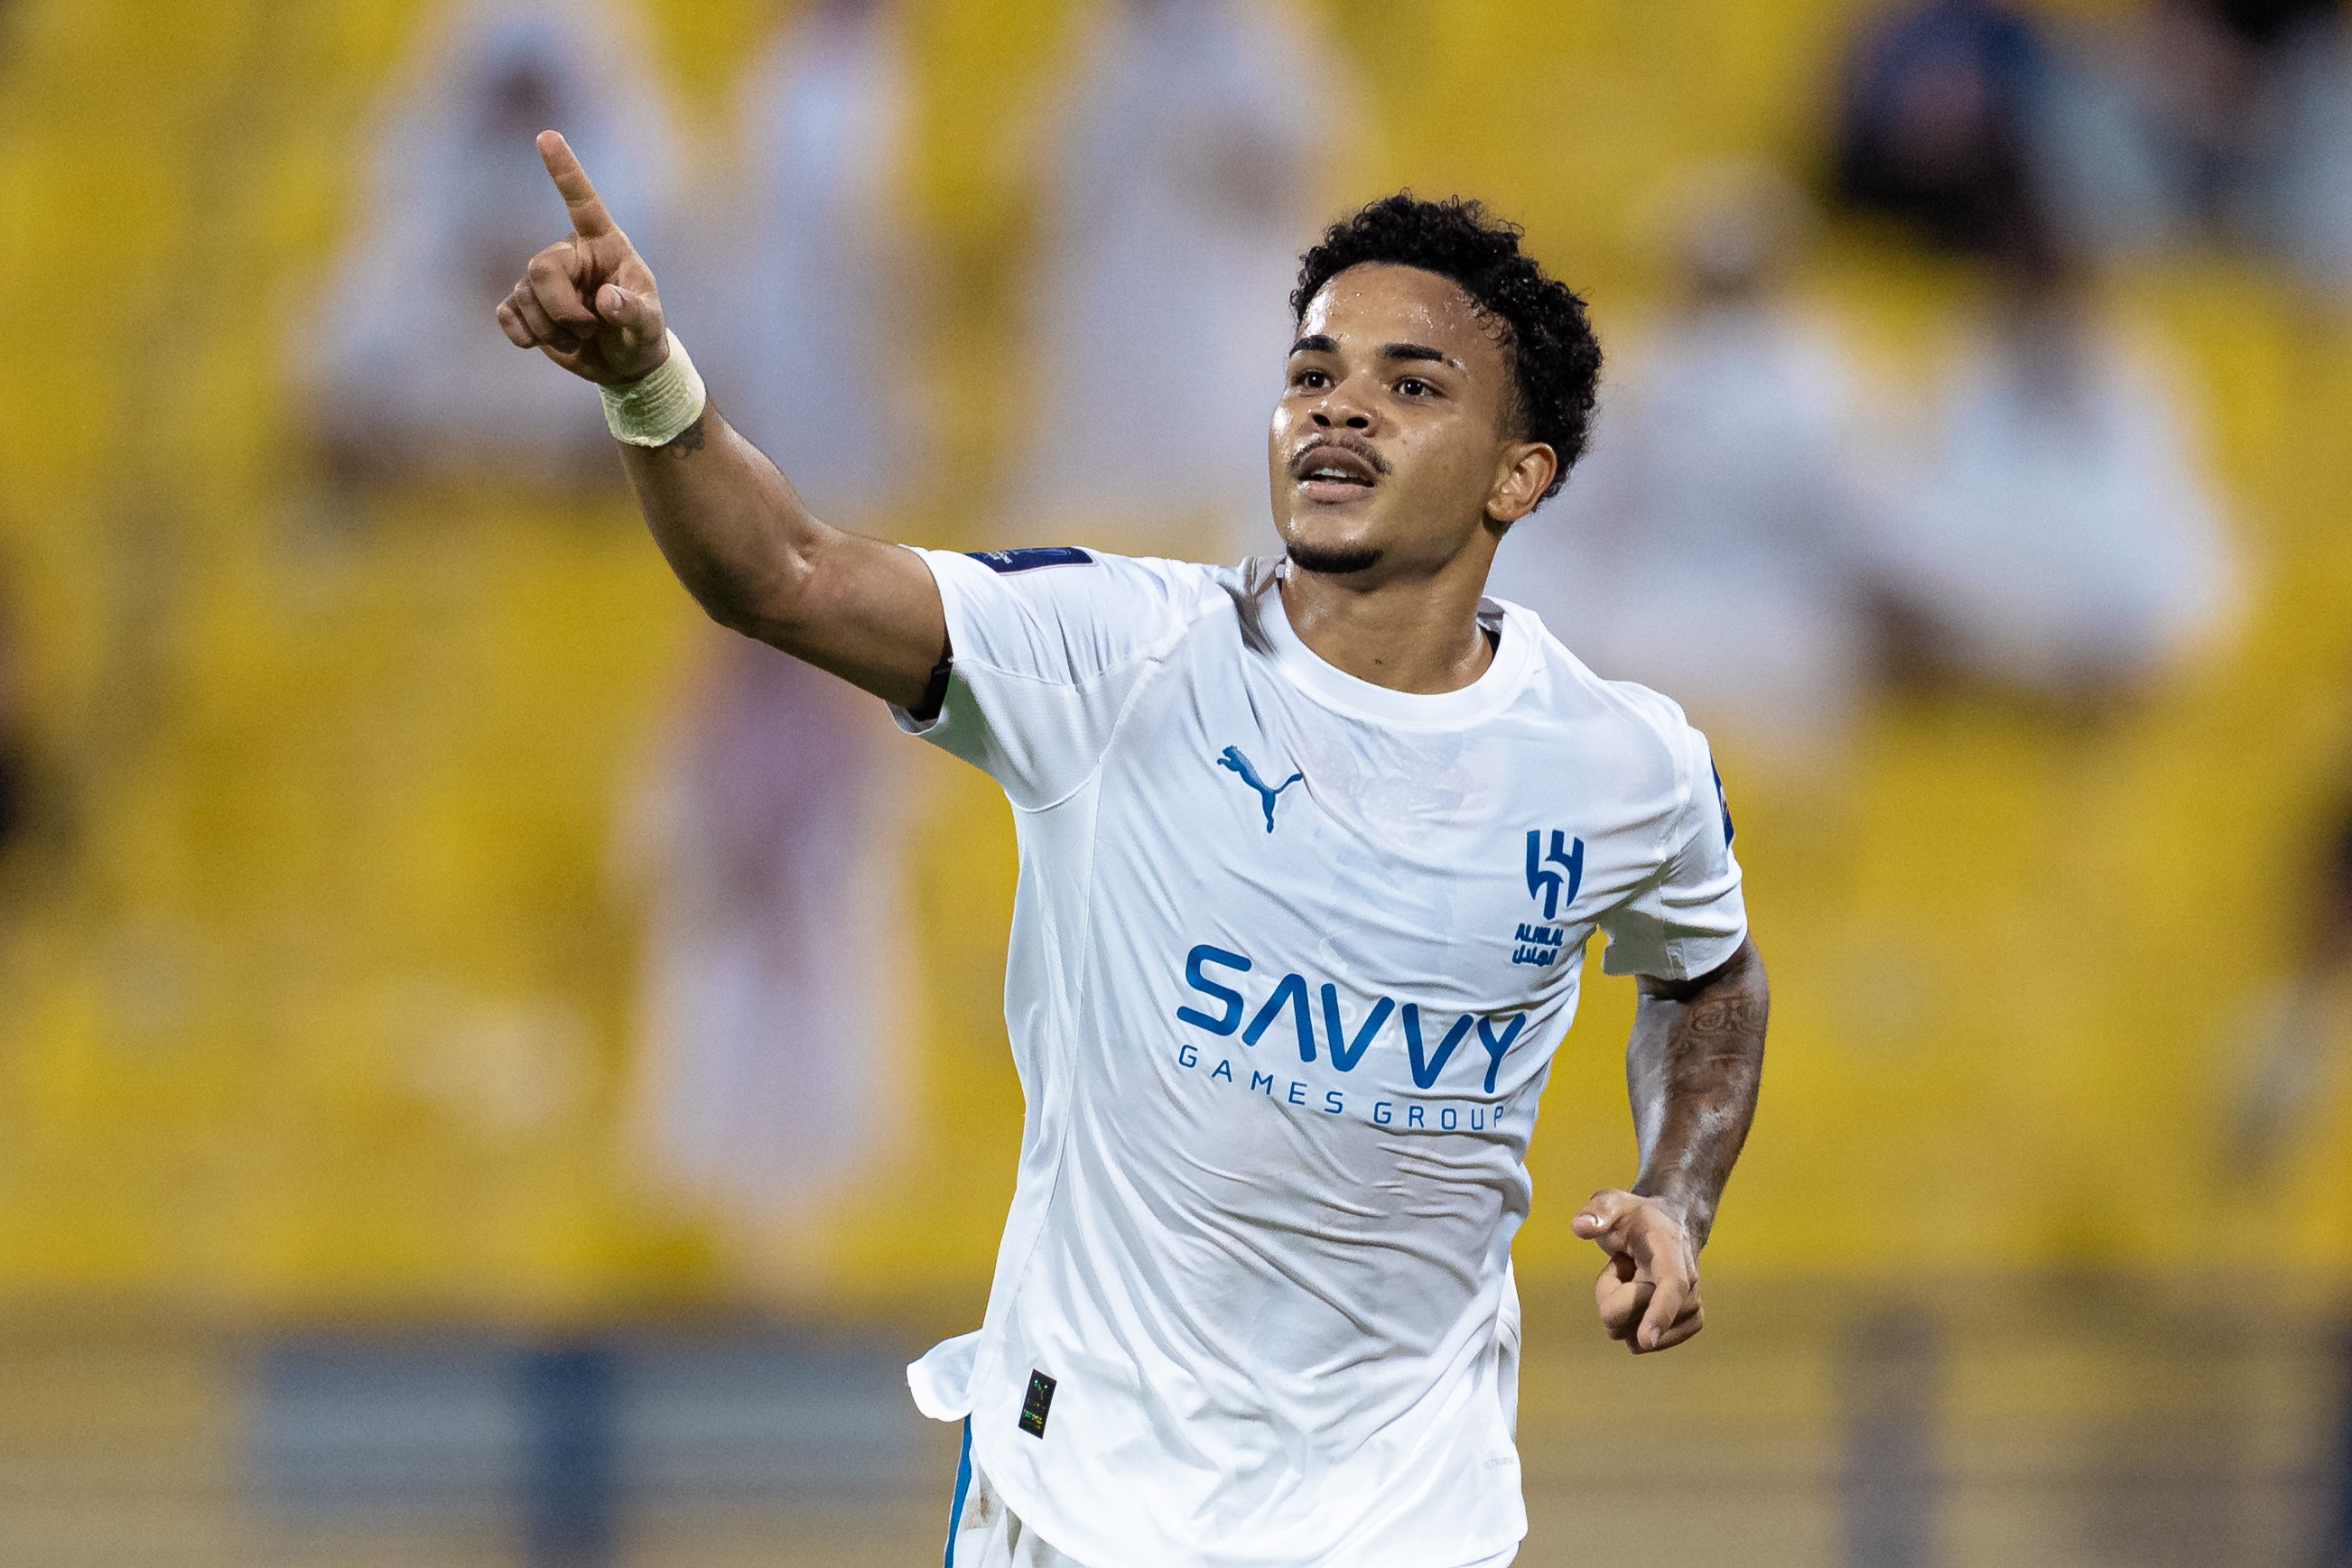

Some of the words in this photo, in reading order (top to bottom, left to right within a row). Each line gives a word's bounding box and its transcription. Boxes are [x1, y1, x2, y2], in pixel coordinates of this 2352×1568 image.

[1176, 943, 1527, 1095] SAVVY
[1177, 1044, 1344, 1116] GAMES
[1372, 1100, 1505, 1132] GROUP
